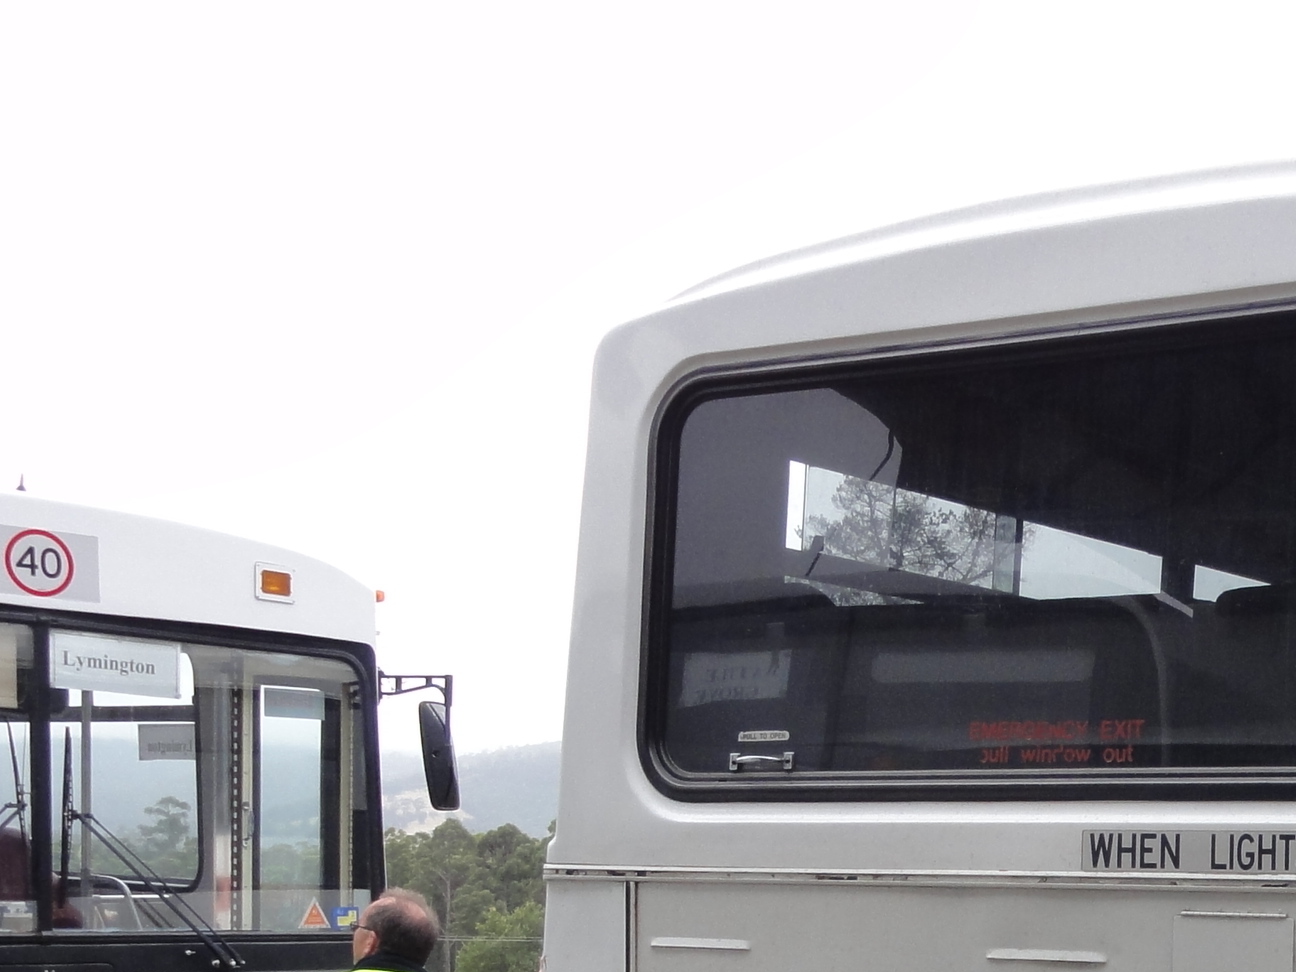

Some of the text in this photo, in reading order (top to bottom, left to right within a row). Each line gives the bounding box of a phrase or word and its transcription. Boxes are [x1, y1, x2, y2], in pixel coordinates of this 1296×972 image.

[15, 545, 62, 579] 40
[62, 650, 156, 676] Lymington
[969, 719, 1146, 741] EMERGENCY EXIT
[1103, 746, 1134, 763] out
[1089, 832, 1181, 869] WHEN
